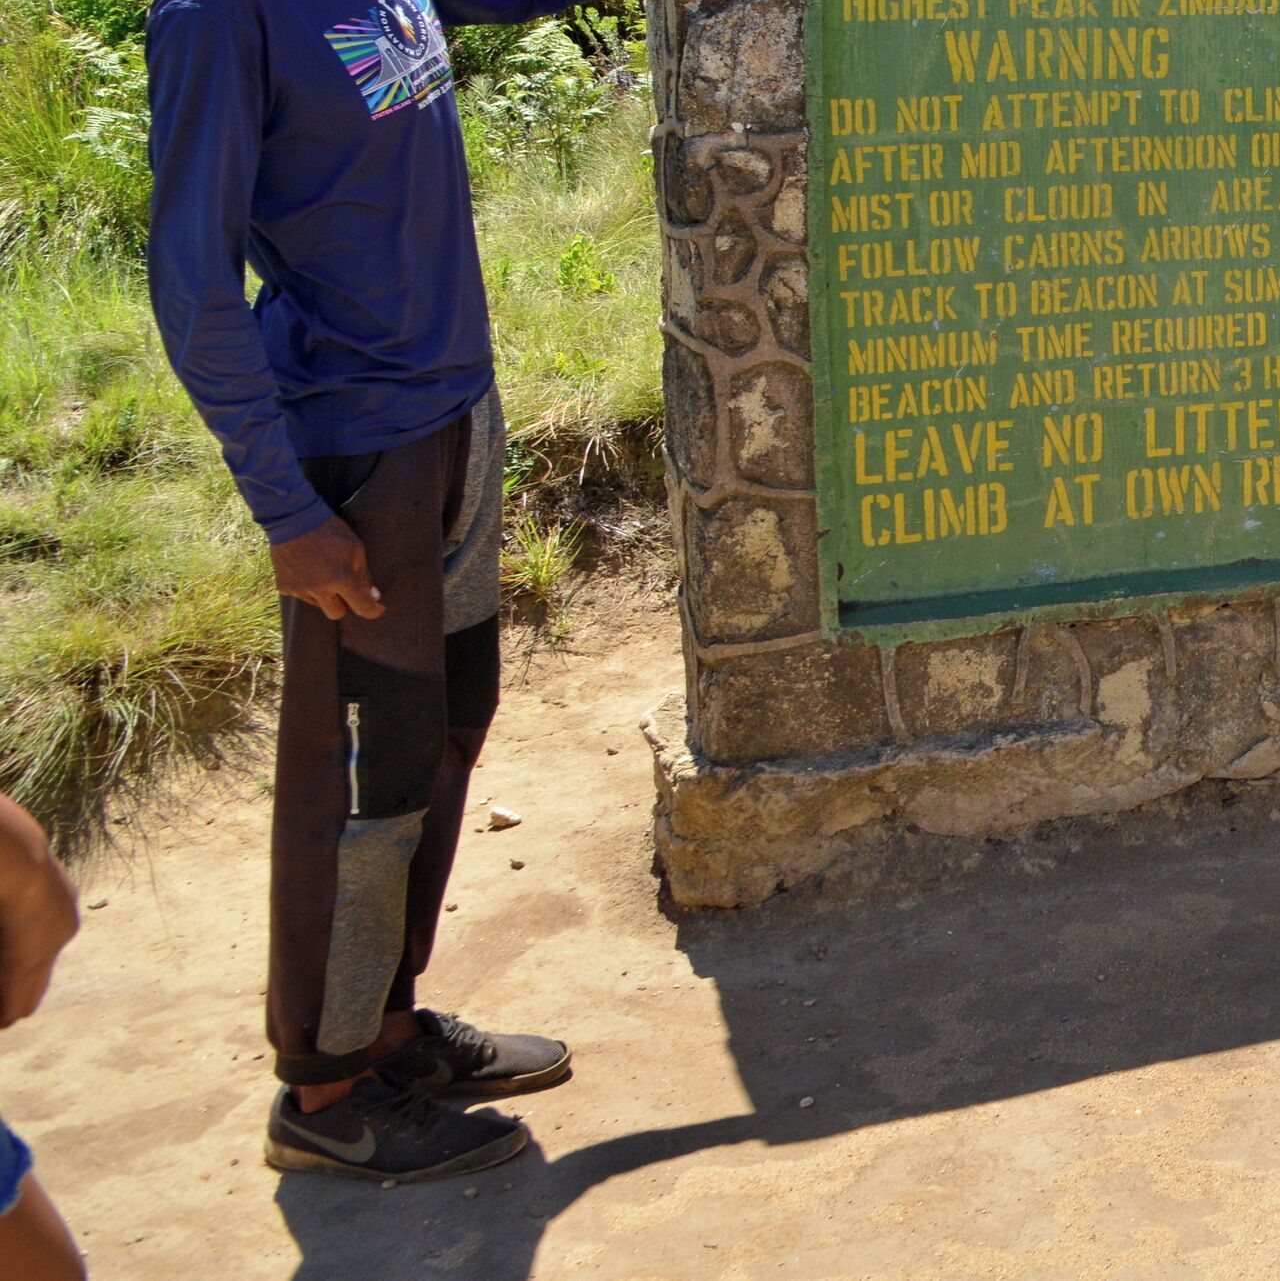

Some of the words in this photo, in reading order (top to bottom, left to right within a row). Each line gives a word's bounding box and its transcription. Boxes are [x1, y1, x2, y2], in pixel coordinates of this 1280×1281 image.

[379, 10, 416, 56] MARATHON
[416, 14, 428, 42] YORK
[944, 25, 1169, 84] WARNING
[831, 98, 876, 136] DO
[897, 95, 963, 135] NOT
[982, 90, 1142, 134] ATTEMPT
[1159, 88, 1200, 124] TO
[831, 143, 943, 185] AFTER
[961, 141, 1021, 179] MID
[1045, 133, 1237, 175] AFTERNOON
[832, 192, 912, 232] MIST
[929, 189, 973, 227] OR
[1004, 182, 1114, 223] CLOUD
[1138, 181, 1167, 216] IN
[839, 236, 980, 281] FOLLOW
[1003, 228, 1125, 271] CAIRNS
[1138, 223, 1271, 264] ARROWS
[840, 286, 958, 328] TRACK
[973, 281, 1018, 320] TO
[1029, 273, 1158, 315] BEACON
[1171, 270, 1210, 306] AT
[848, 329, 997, 375] MINIMUM
[1016, 324, 1094, 363] TIME
[1110, 311, 1267, 356] REQUIRED
[849, 375, 988, 423] BEACON
[1010, 369, 1076, 408] AND
[1093, 360, 1222, 401] RETURN
[1232, 356, 1254, 393] 3
[854, 420, 1014, 485] LEAVE
[1043, 413, 1103, 467] NO
[861, 482, 1008, 547] CLIMB
[1044, 471, 1101, 528] AT
[1126, 461, 1221, 518] OWN
